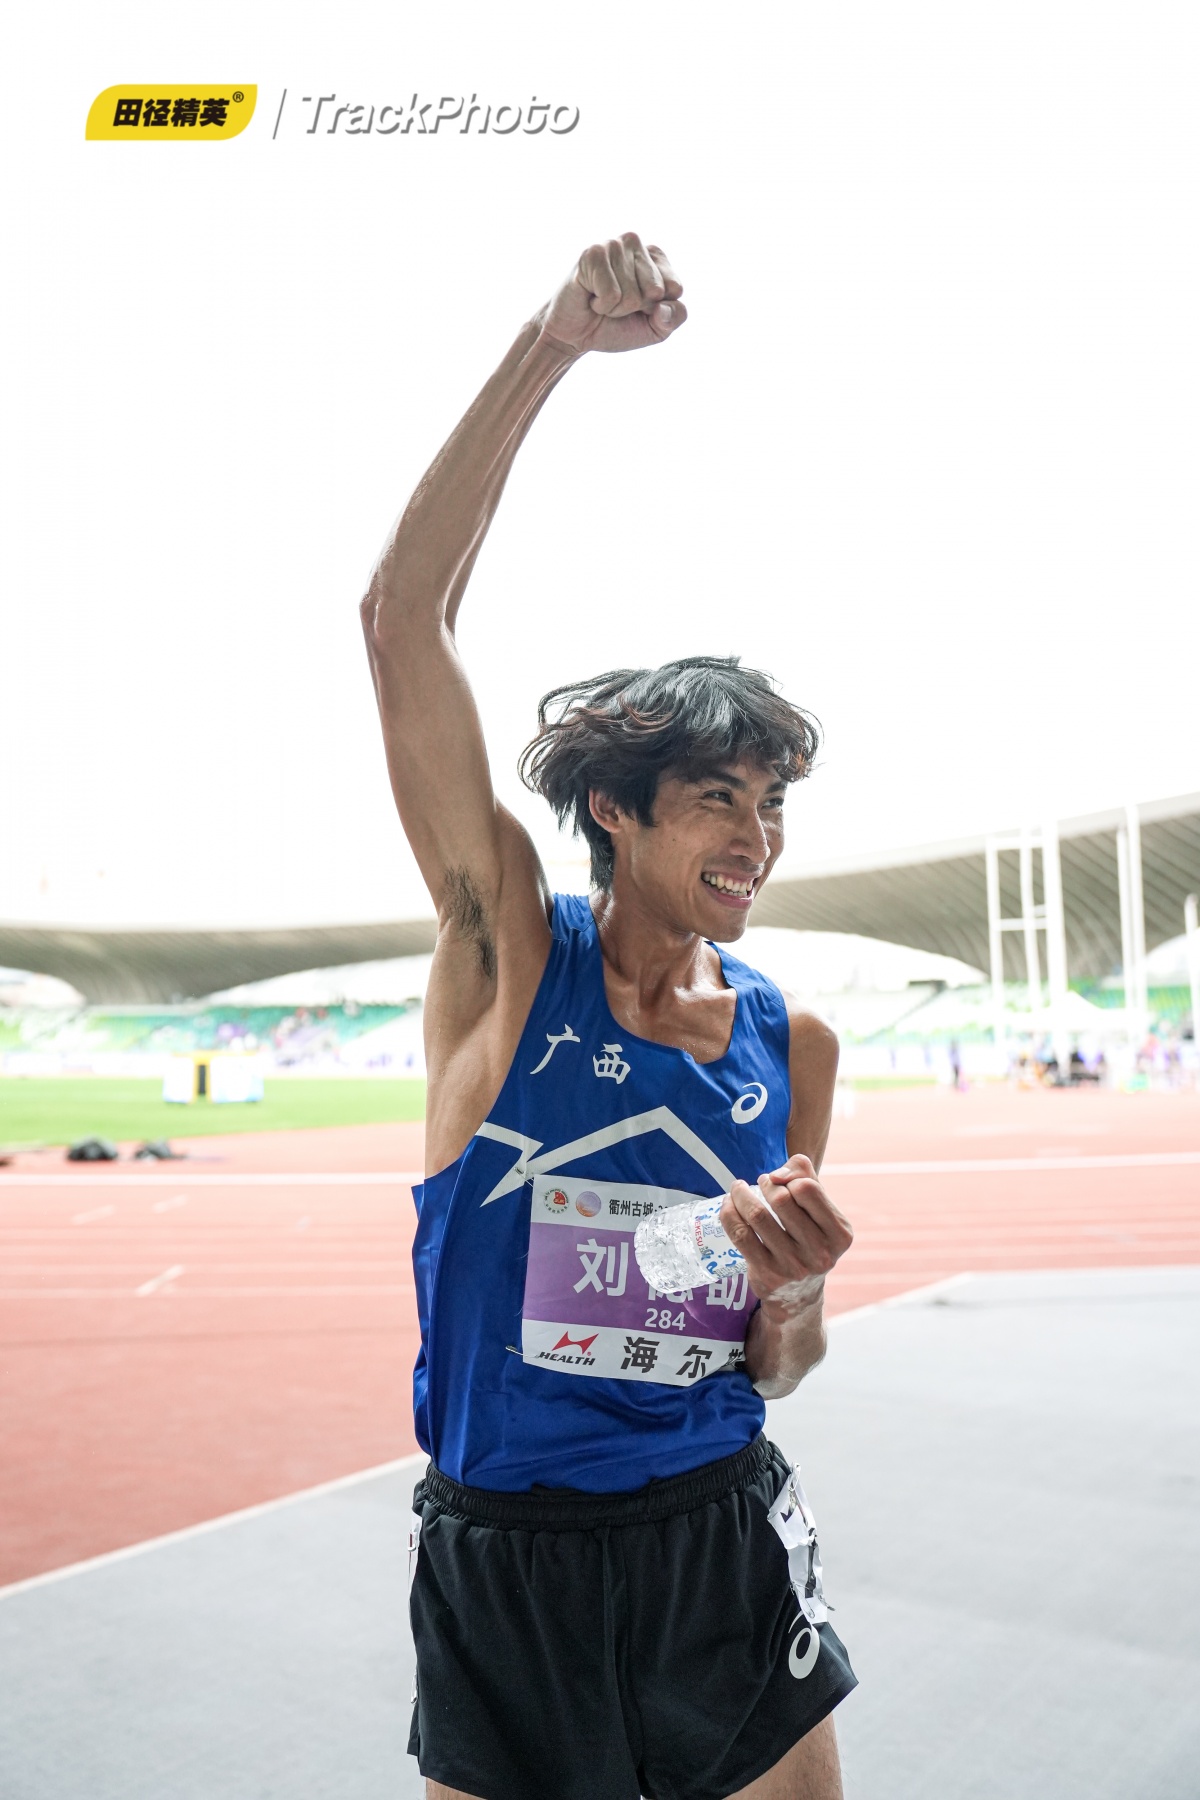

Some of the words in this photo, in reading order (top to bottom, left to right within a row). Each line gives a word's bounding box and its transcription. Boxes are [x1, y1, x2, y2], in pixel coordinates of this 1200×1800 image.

[530, 1023, 631, 1085] 广西
[644, 1308, 686, 1331] 284
[539, 1351, 596, 1366] HEALTH
